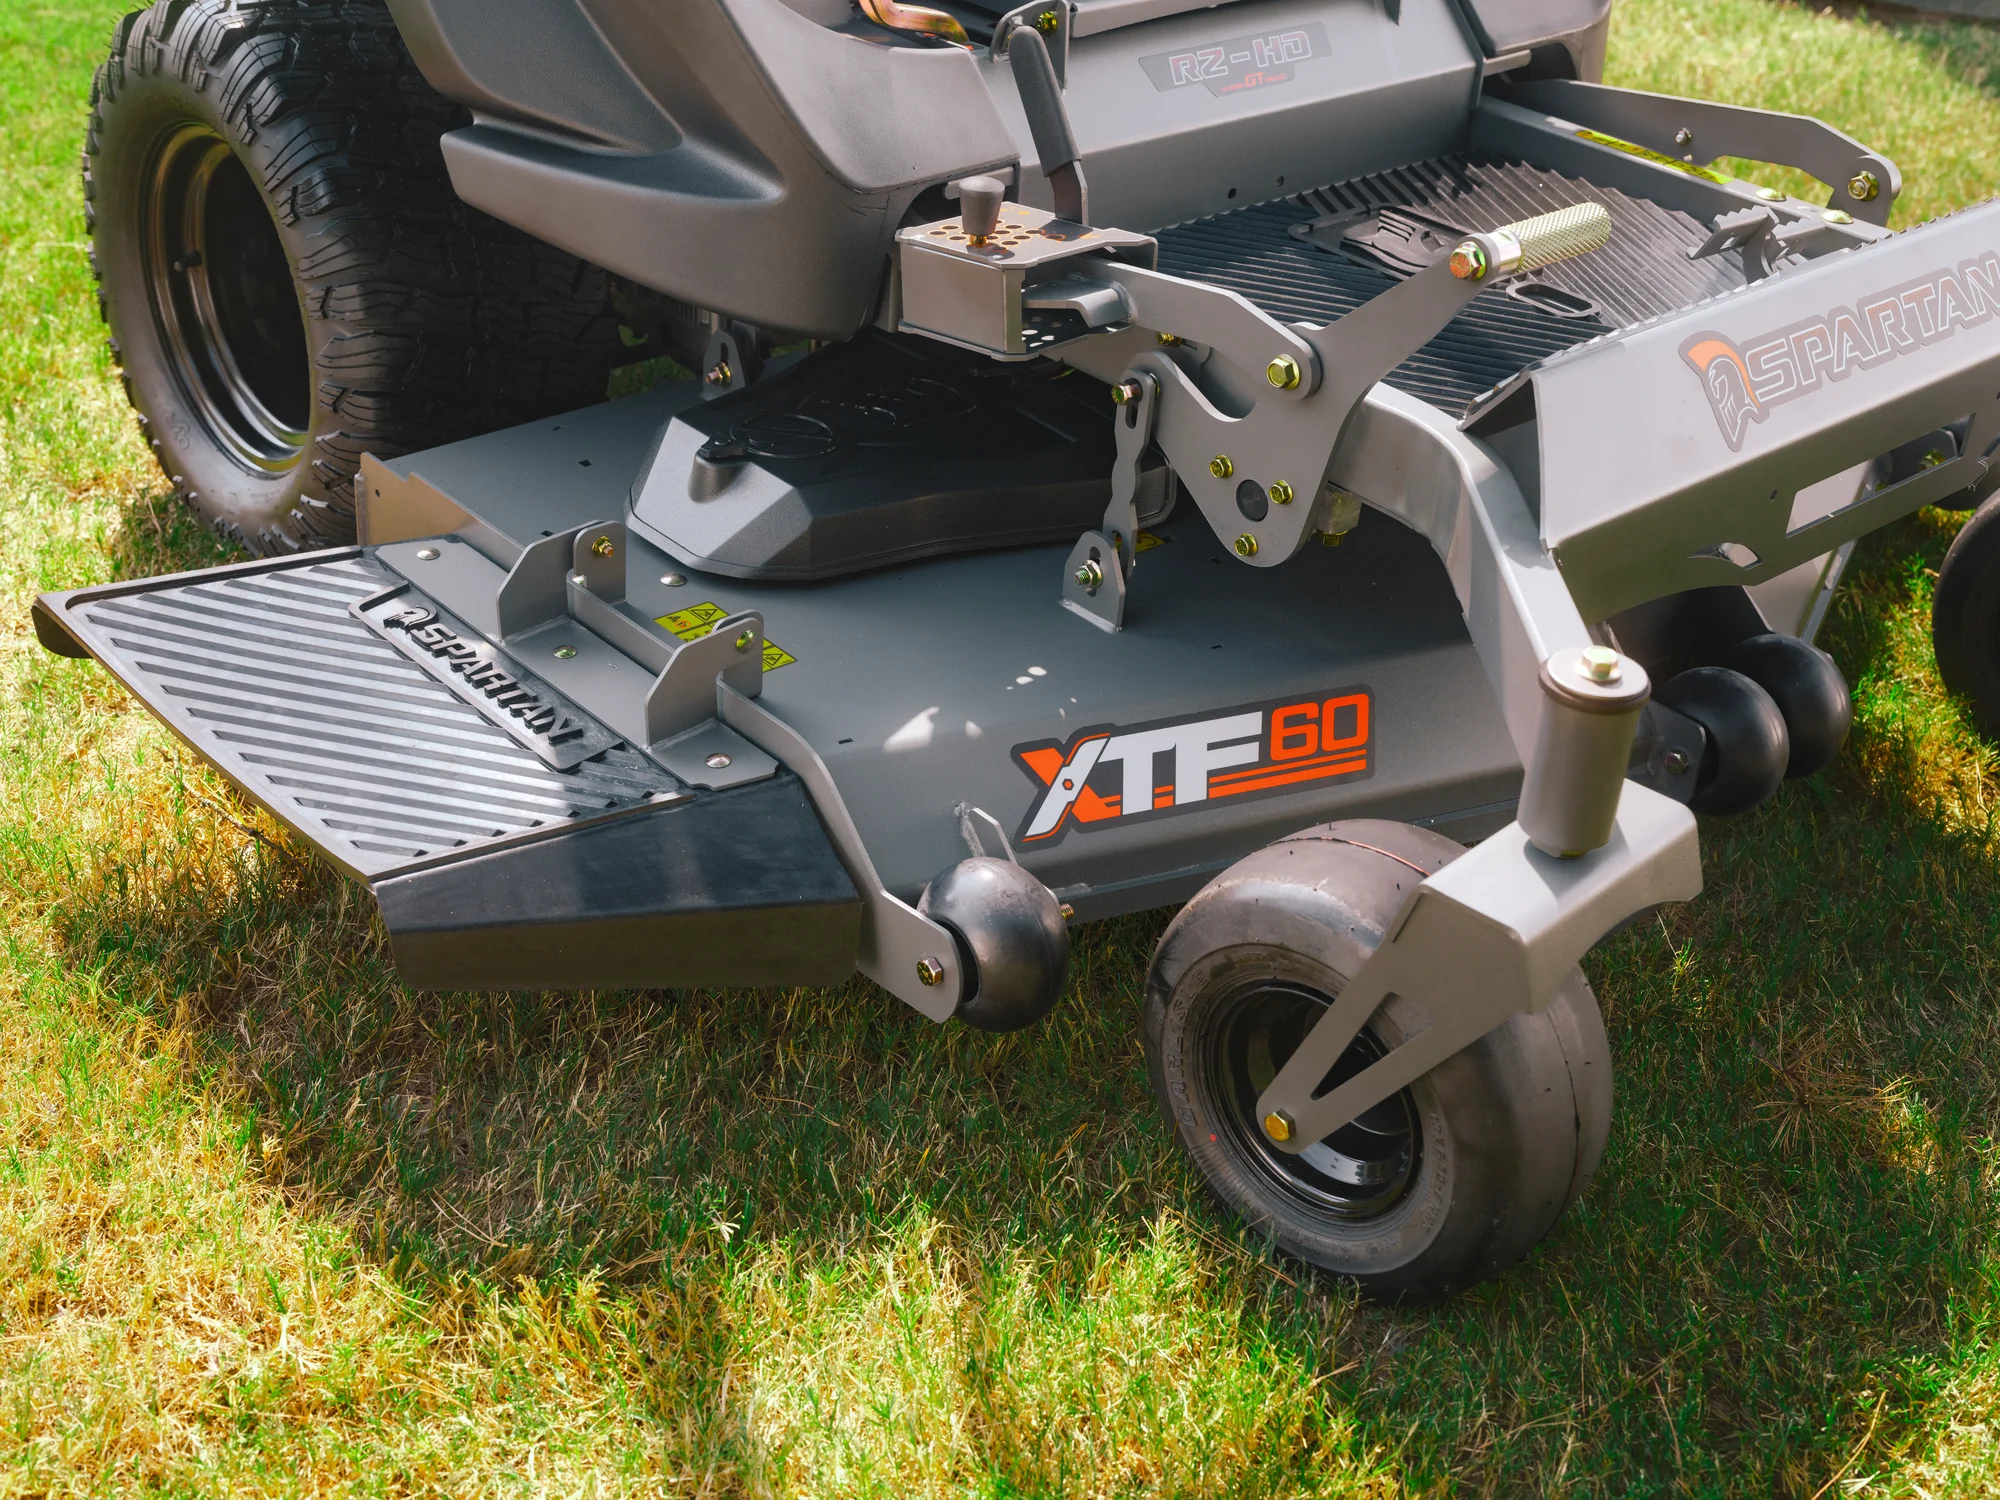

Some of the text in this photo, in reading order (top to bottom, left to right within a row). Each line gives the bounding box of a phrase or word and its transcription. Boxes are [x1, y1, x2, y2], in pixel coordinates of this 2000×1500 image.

[1169, 30, 1312, 86] RZ-HD
[1245, 71, 1265, 87] GT
[1746, 258, 2000, 403] SPARTAN
[410, 622, 584, 747] SPARTAN
[1167, 967, 1212, 1128] CARLISLE
